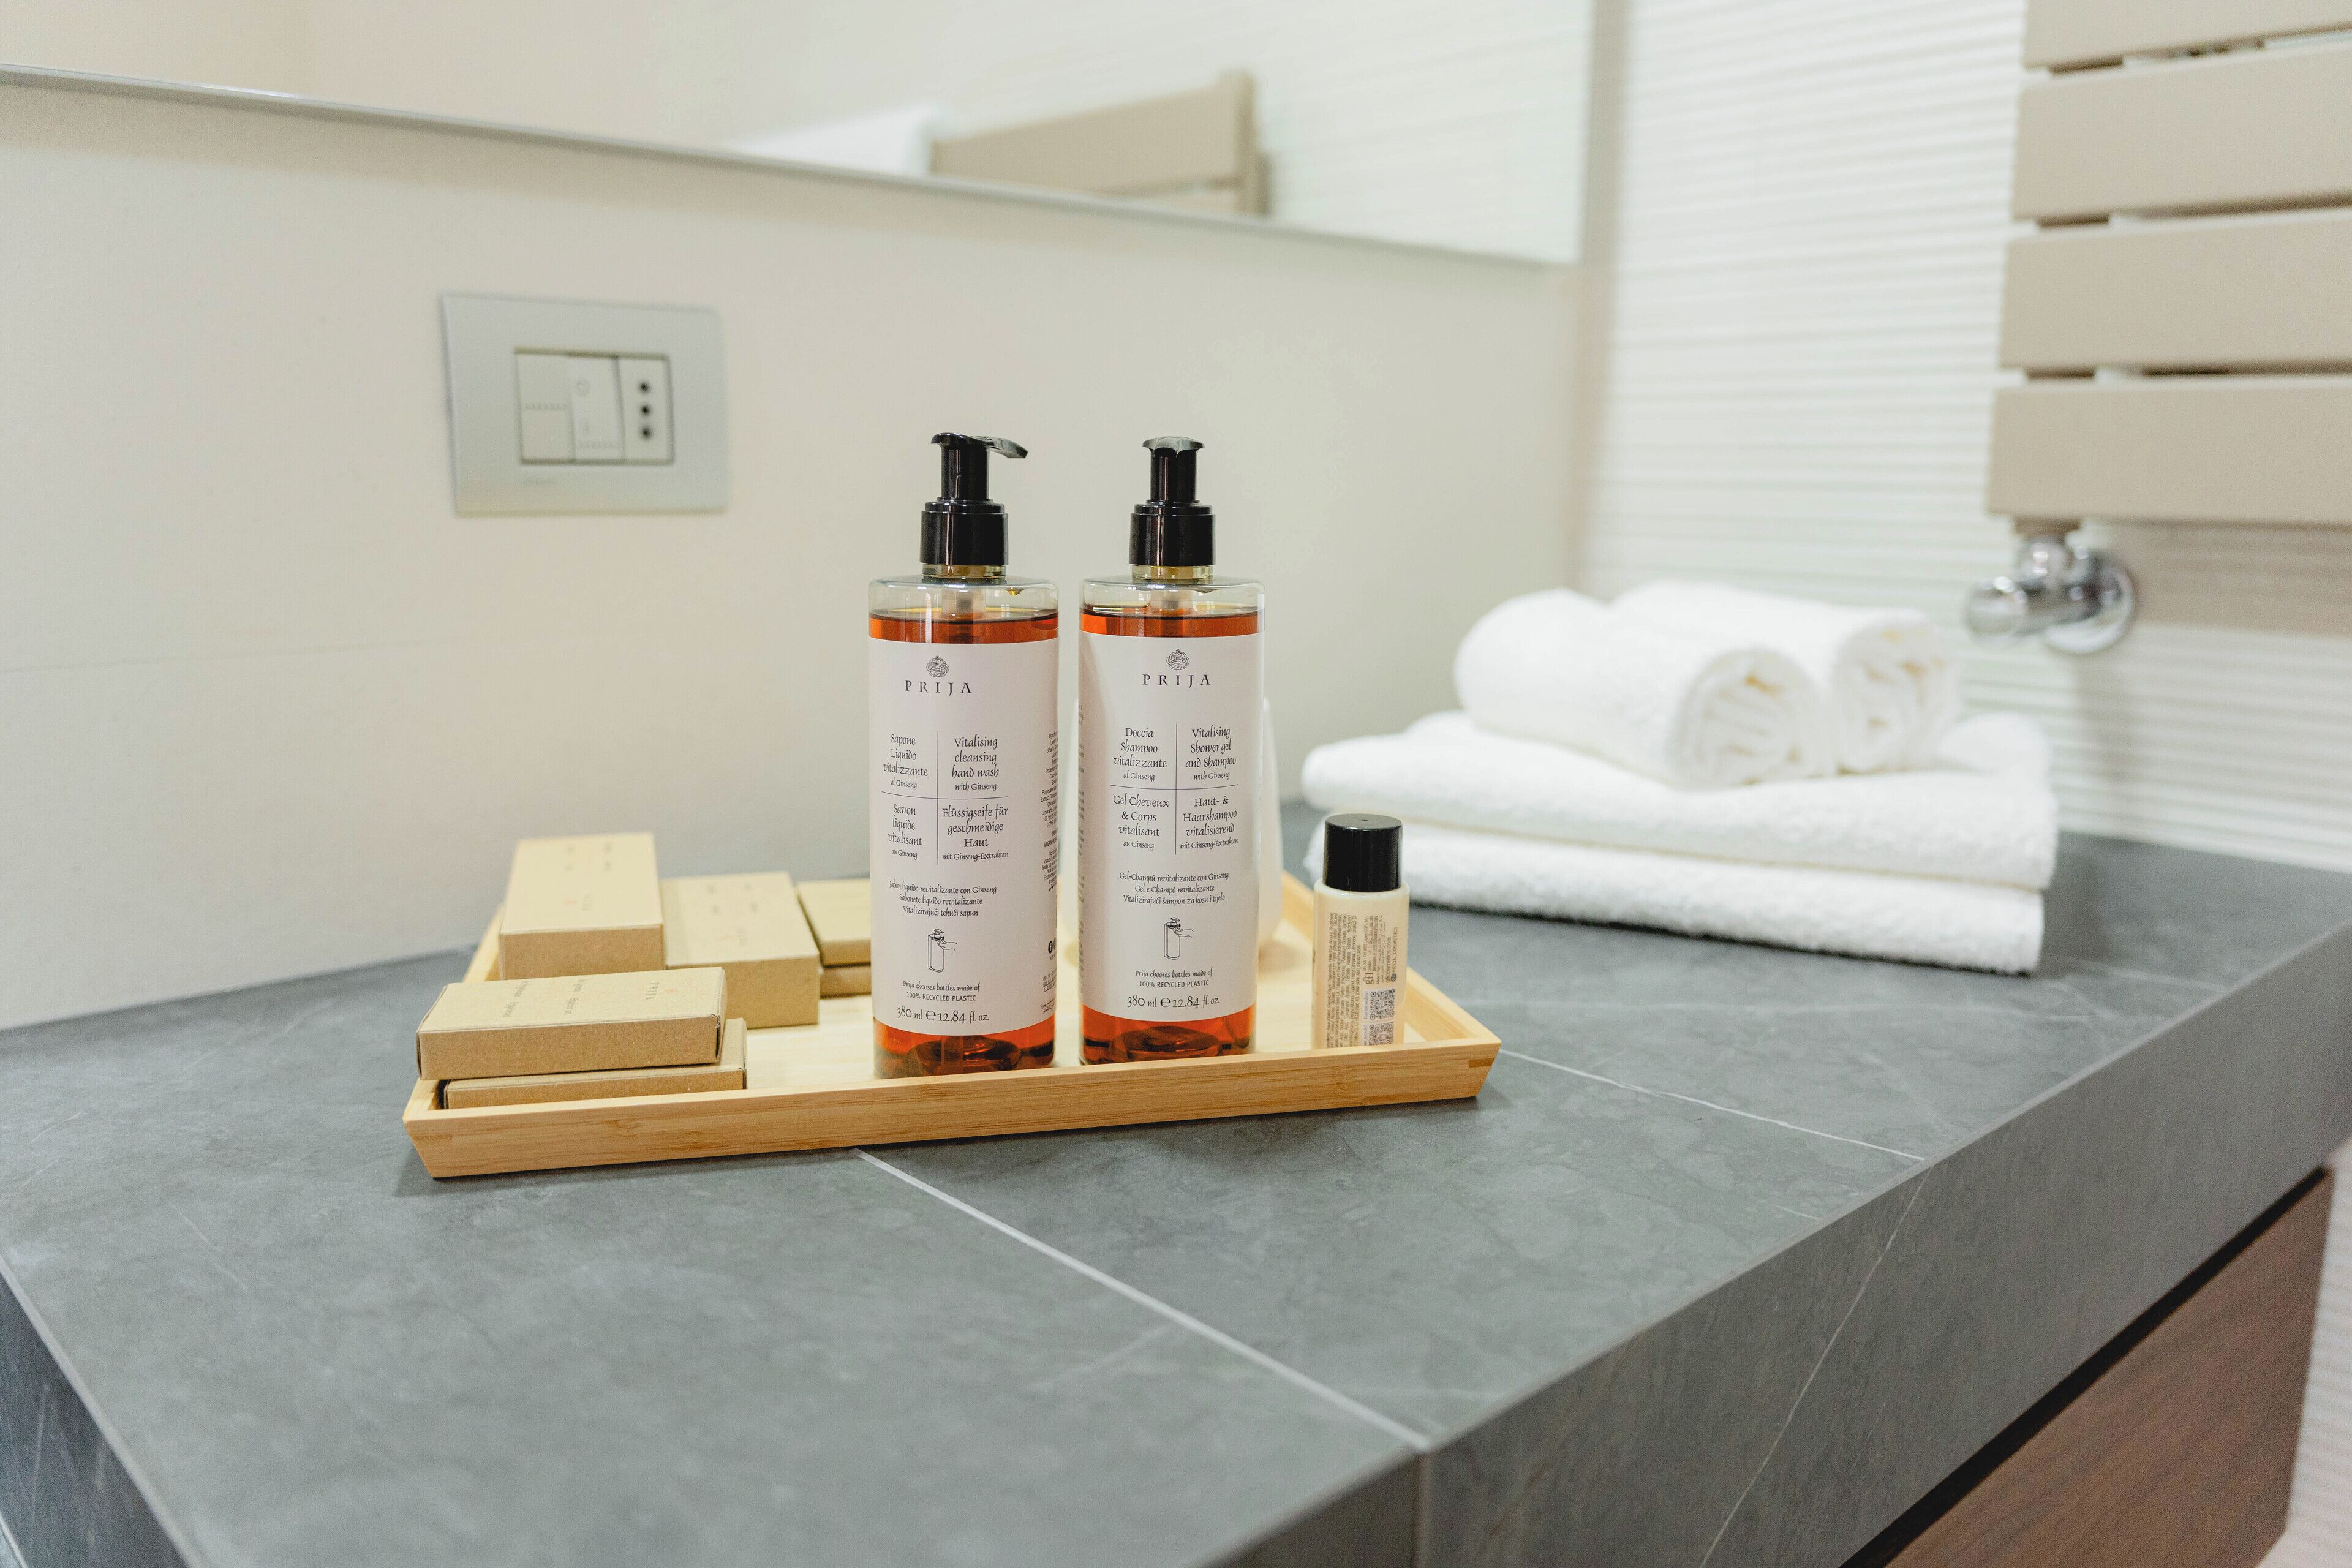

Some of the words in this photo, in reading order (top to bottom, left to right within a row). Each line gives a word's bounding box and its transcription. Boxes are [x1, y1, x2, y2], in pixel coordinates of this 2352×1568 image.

[1143, 674, 1210, 688] PRIJA
[905, 680, 972, 696] PRIJA
[1125, 728, 1153, 737] Doccia
[1192, 725, 1231, 739] Vitalising
[891, 734, 916, 747] Sapone
[954, 734, 998, 749] Vitalising
[1121, 739, 1158, 753] Shampoo
[1191, 740, 1219, 755] Shower
[1221, 739, 1231, 755] gel
[891, 749, 916, 762] Liquido
[954, 750, 997, 763] cleansing
[1113, 754, 1167, 768] vitalizzante
[1185, 758, 1201, 768] and
[1204, 755, 1237, 769] Shampoo
[883, 761, 929, 776] vitalizzante
[952, 765, 974, 779] hand
[978, 764, 999, 778] wash
[1131, 772, 1155, 782] Ginseng
[1194, 771, 1207, 781] with
[1208, 771, 1230, 780] Ginseng
[896, 780, 917, 790] Ginseng
[955, 780, 970, 791] with
[971, 782, 997, 791] Ginseng
[1113, 793, 1127, 805] Gel
[1129, 794, 1169, 807] Cheveux
[1194, 797, 1219, 807] Haut-
[1223, 796, 1229, 804] &
[894, 804, 916, 815] Savon
[943, 805, 993, 820] Flüssigseife
[995, 803, 1009, 819] für
[1183, 808, 1237, 822] Haarshampoo
[892, 815, 916, 831] liquide
[1121, 811, 1129, 820] &
[1131, 812, 1156, 824] Corps
[948, 820, 1003, 835] geschmeidige
[1118, 823, 1159, 836] vitalisant
[1186, 823, 1235, 837] vitalisierend
[888, 831, 922, 846] vitalisant
[964, 839, 989, 848] Haut
[1191, 837, 1238, 850] Ginseng-Extrakten
[1131, 841, 1154, 851] Ginseng
[898, 848, 918, 860] Ginseng
[954, 851, 1009, 862] Ginseng-Extrakten
[1157, 873, 1196, 882] revitalizante
[1208, 872, 1229, 881] Ginseng
[920, 884, 959, 894] revitalizante
[973, 885, 997, 894] Ginseng
[1135, 884, 1145, 893] Gel
[1177, 883, 1215, 893] revitalizante
[899, 894, 921, 904] Sabonete
[943, 895, 982, 905] revitalizante
[1196, 894, 1208, 904] kosu
[1213, 892, 1225, 904] tijelo
[960, 910, 978, 919] sapun
[1150, 969, 1170, 979] chooses
[1172, 969, 1191, 978] bottles
[1207, 967, 1213, 979] of
[1363, 972, 1374, 984] gfl
[903, 981, 914, 990] Prija
[916, 981, 935, 991] chooses
[937, 982, 956, 992] bottles
[974, 982, 980, 992] of
[1127, 994, 1145, 1008] 380
[1148, 997, 1157, 1008] ml
[897, 1005, 912, 1019] 380
[914, 1009, 922, 1020] ml
